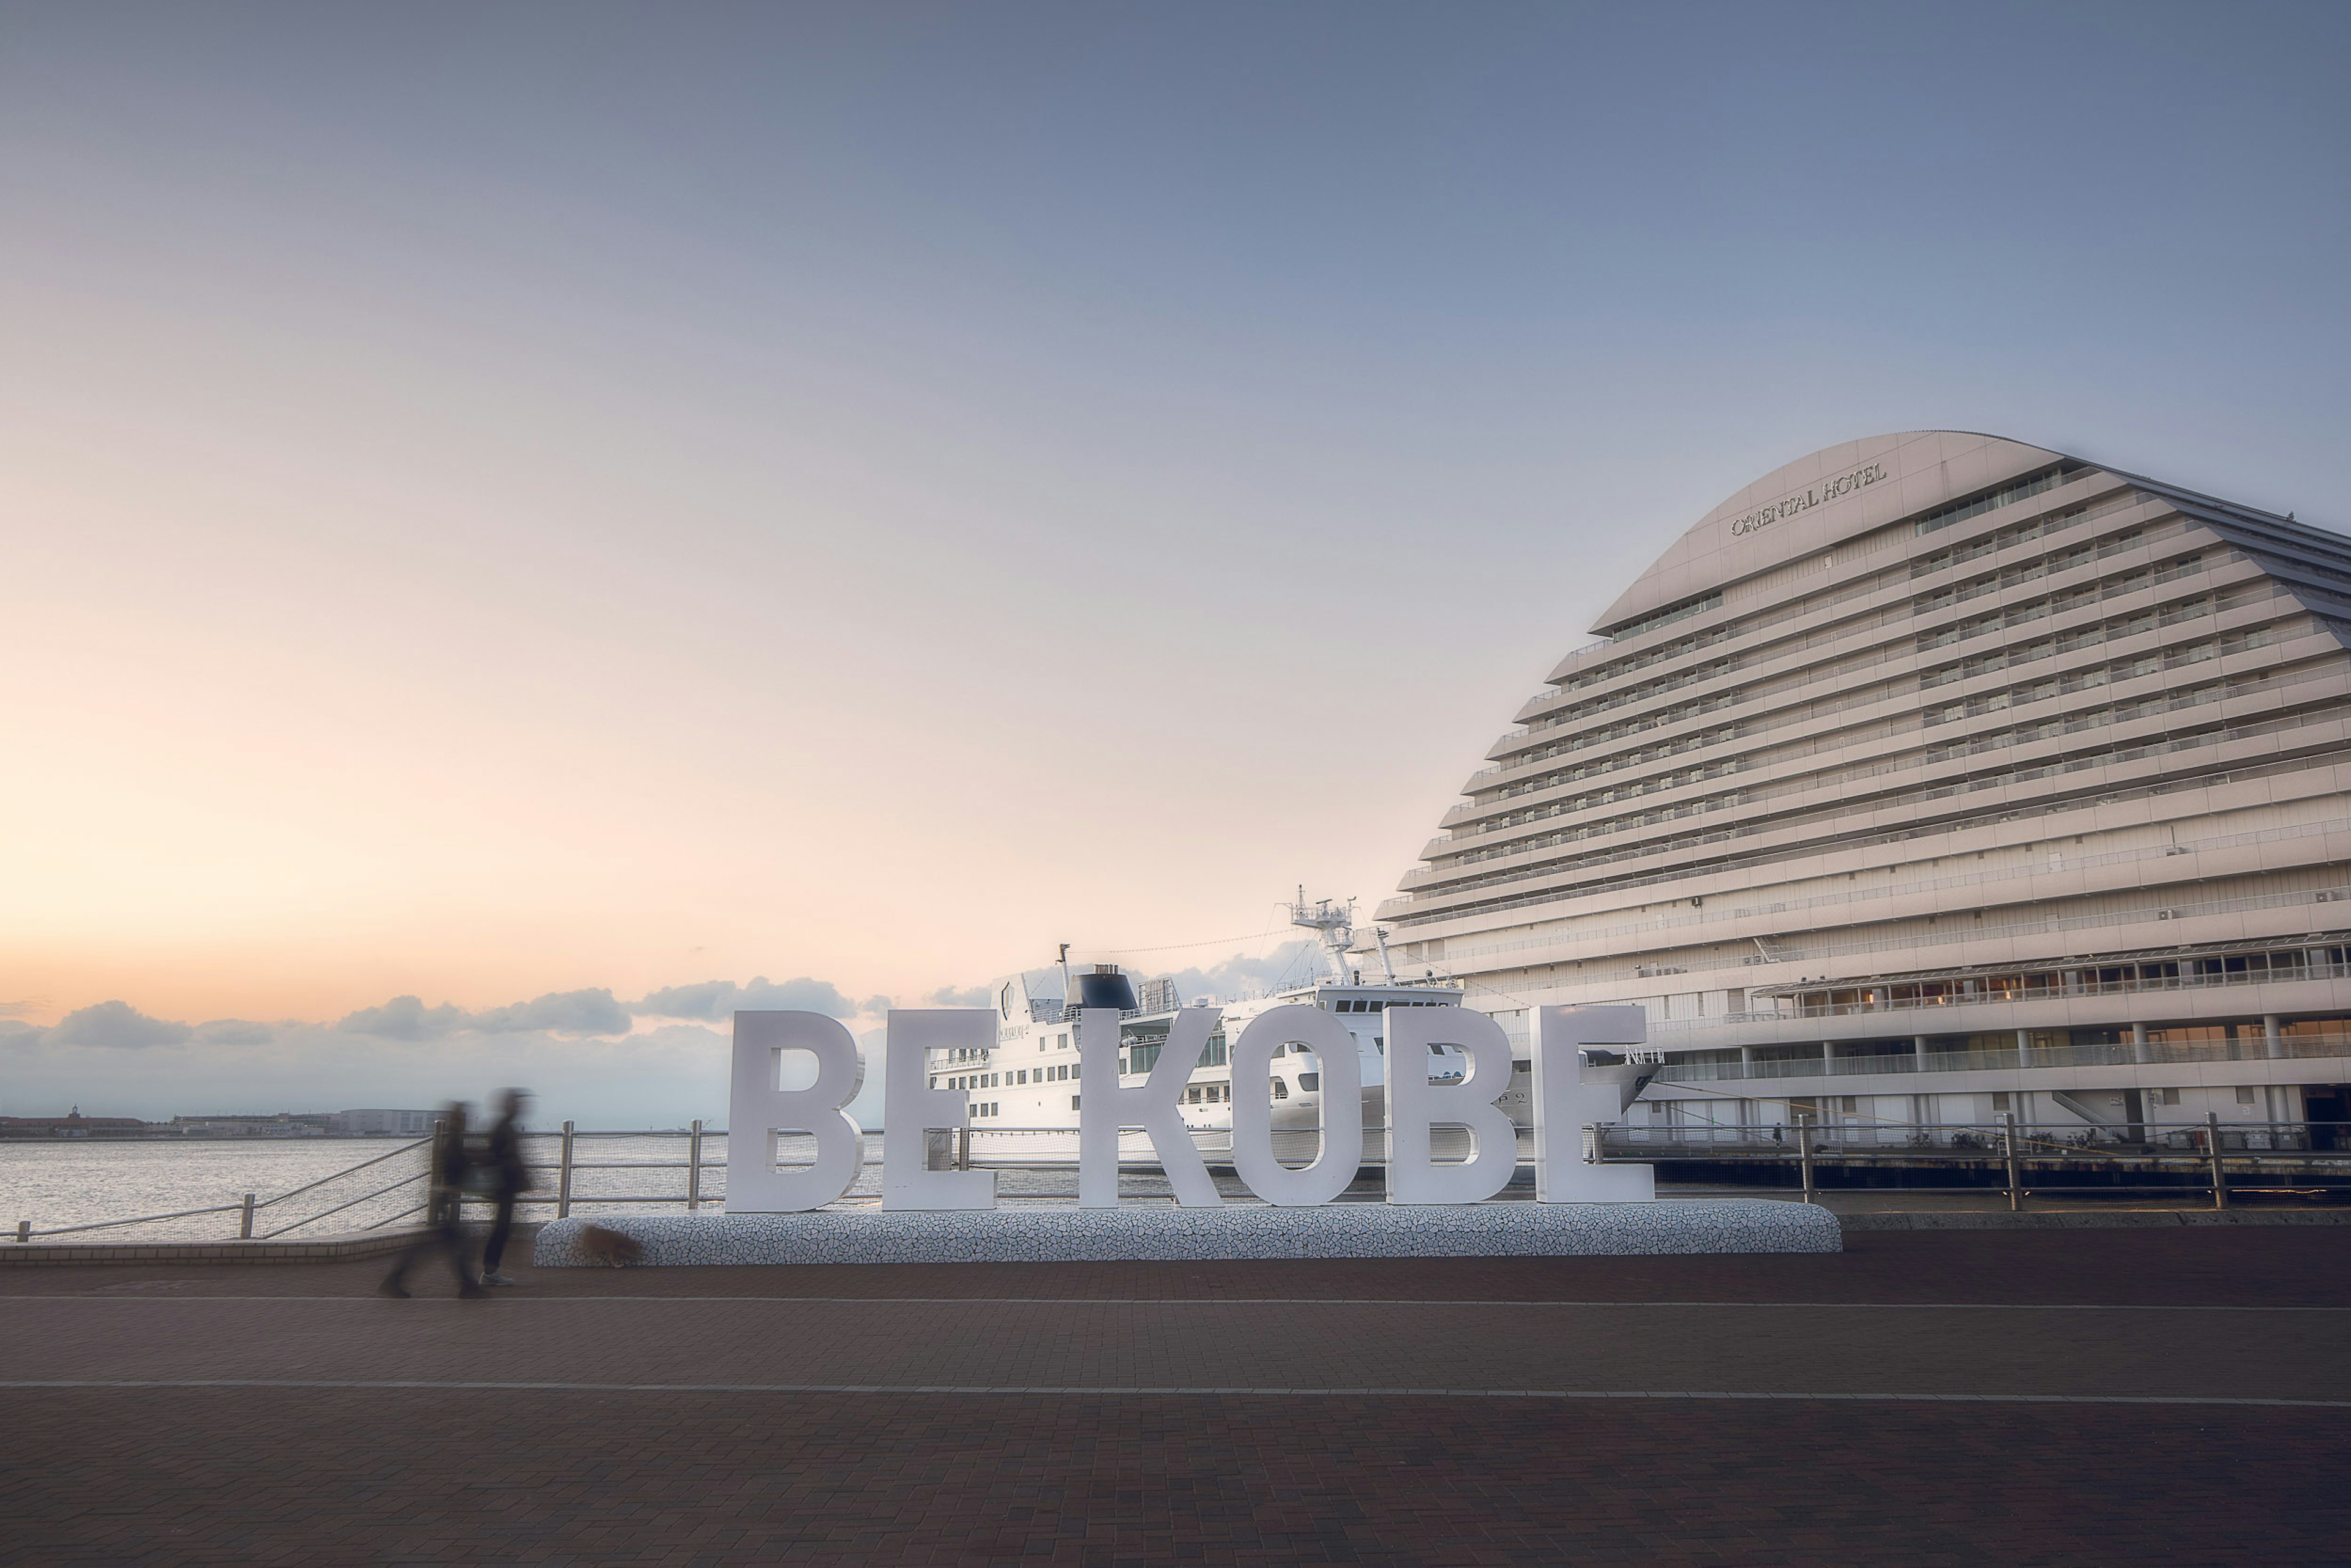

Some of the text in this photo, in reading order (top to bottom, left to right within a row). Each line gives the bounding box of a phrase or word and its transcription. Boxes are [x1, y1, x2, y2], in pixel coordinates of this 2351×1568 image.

[1730, 463, 1886, 536] ORIENTAL HOTEL
[725, 1005, 1655, 1212] BE KOBE
